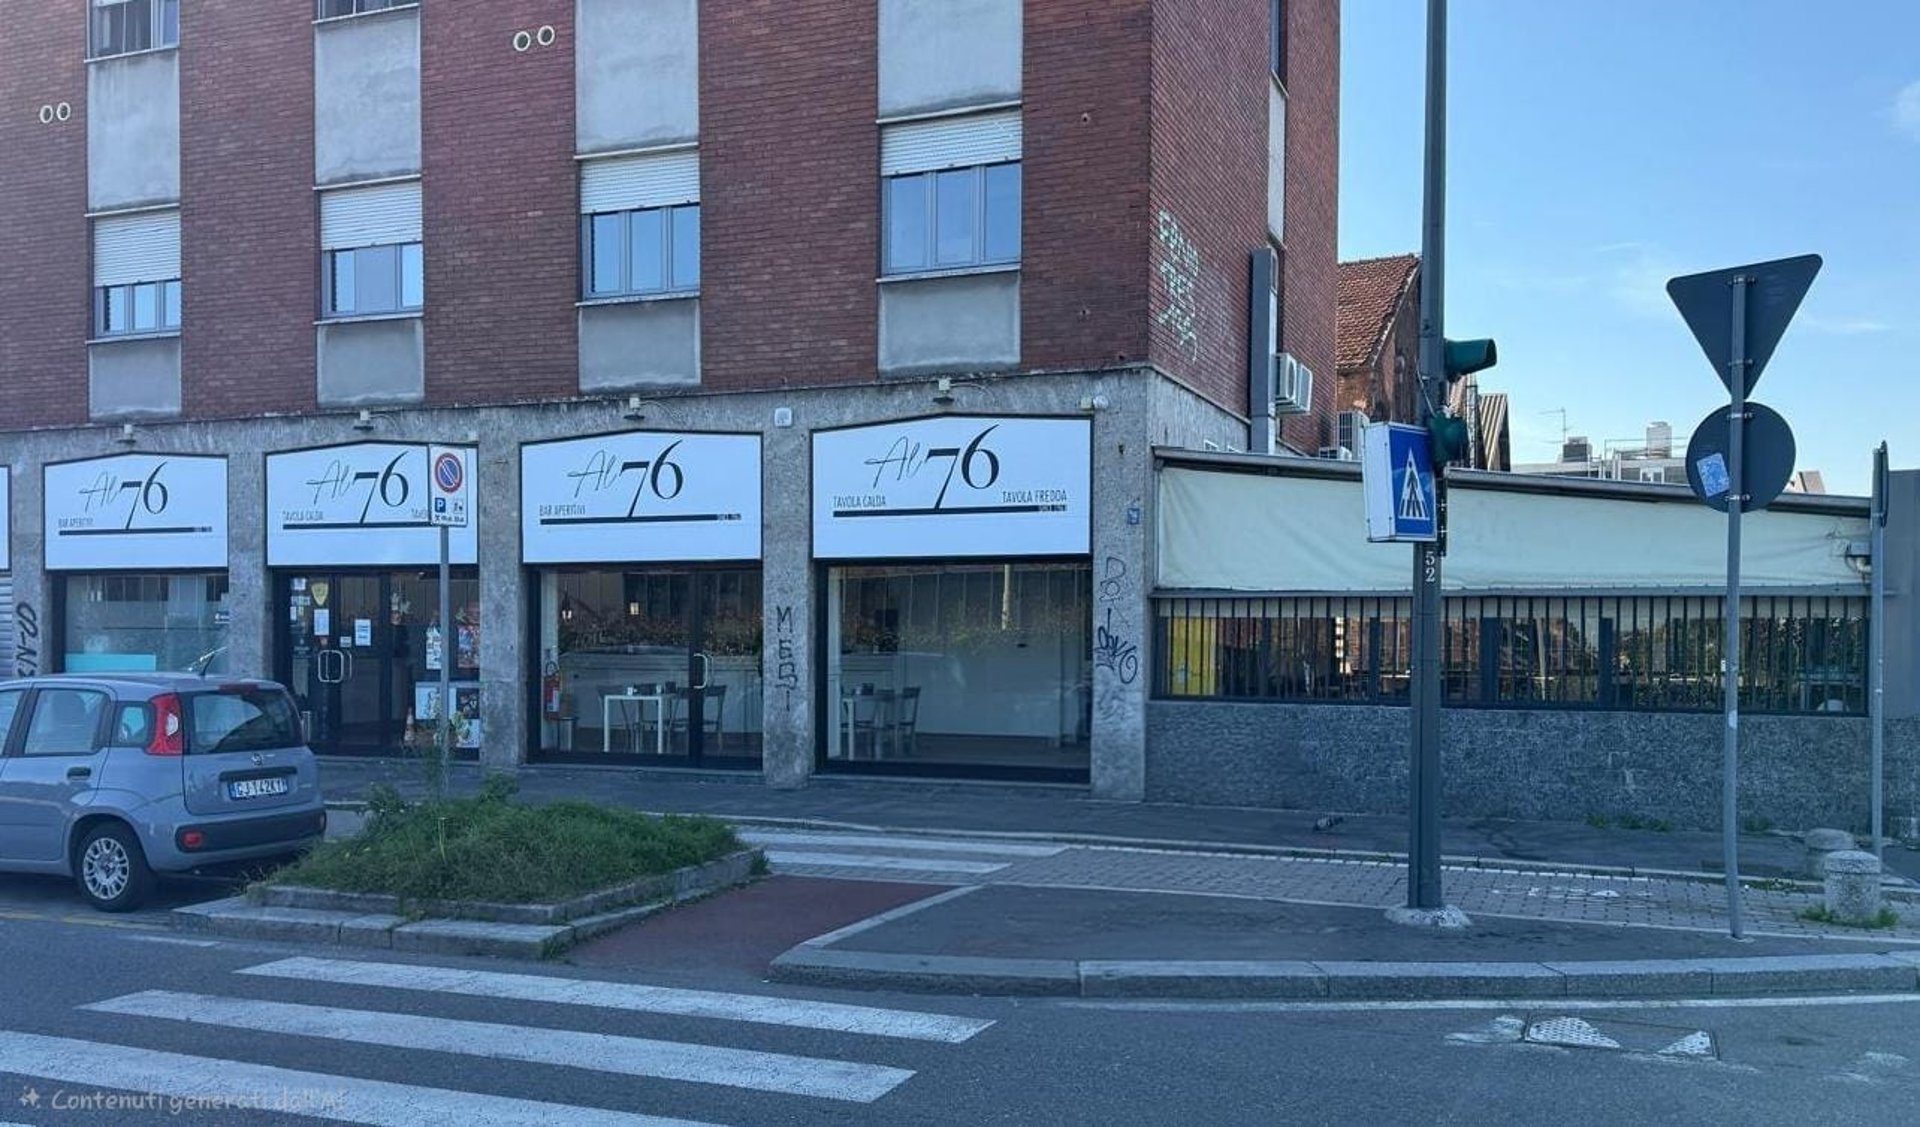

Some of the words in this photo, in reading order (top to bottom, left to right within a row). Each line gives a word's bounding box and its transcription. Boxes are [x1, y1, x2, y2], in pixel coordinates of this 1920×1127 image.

[352, 450, 409, 524] 76
[568, 450, 618, 498] Al
[619, 439, 683, 517] 76
[864, 436, 923, 489] Al
[924, 424, 1000, 509] 76
[121, 461, 168, 530] 76
[540, 504, 552, 517] BAR
[833, 495, 861, 508] TAVOLA
[862, 494, 886, 508] CALDA
[1002, 490, 1033, 503] TAVOLA
[1035, 489, 1067, 502] FREDDA
[1425, 551, 1435, 582] 52
